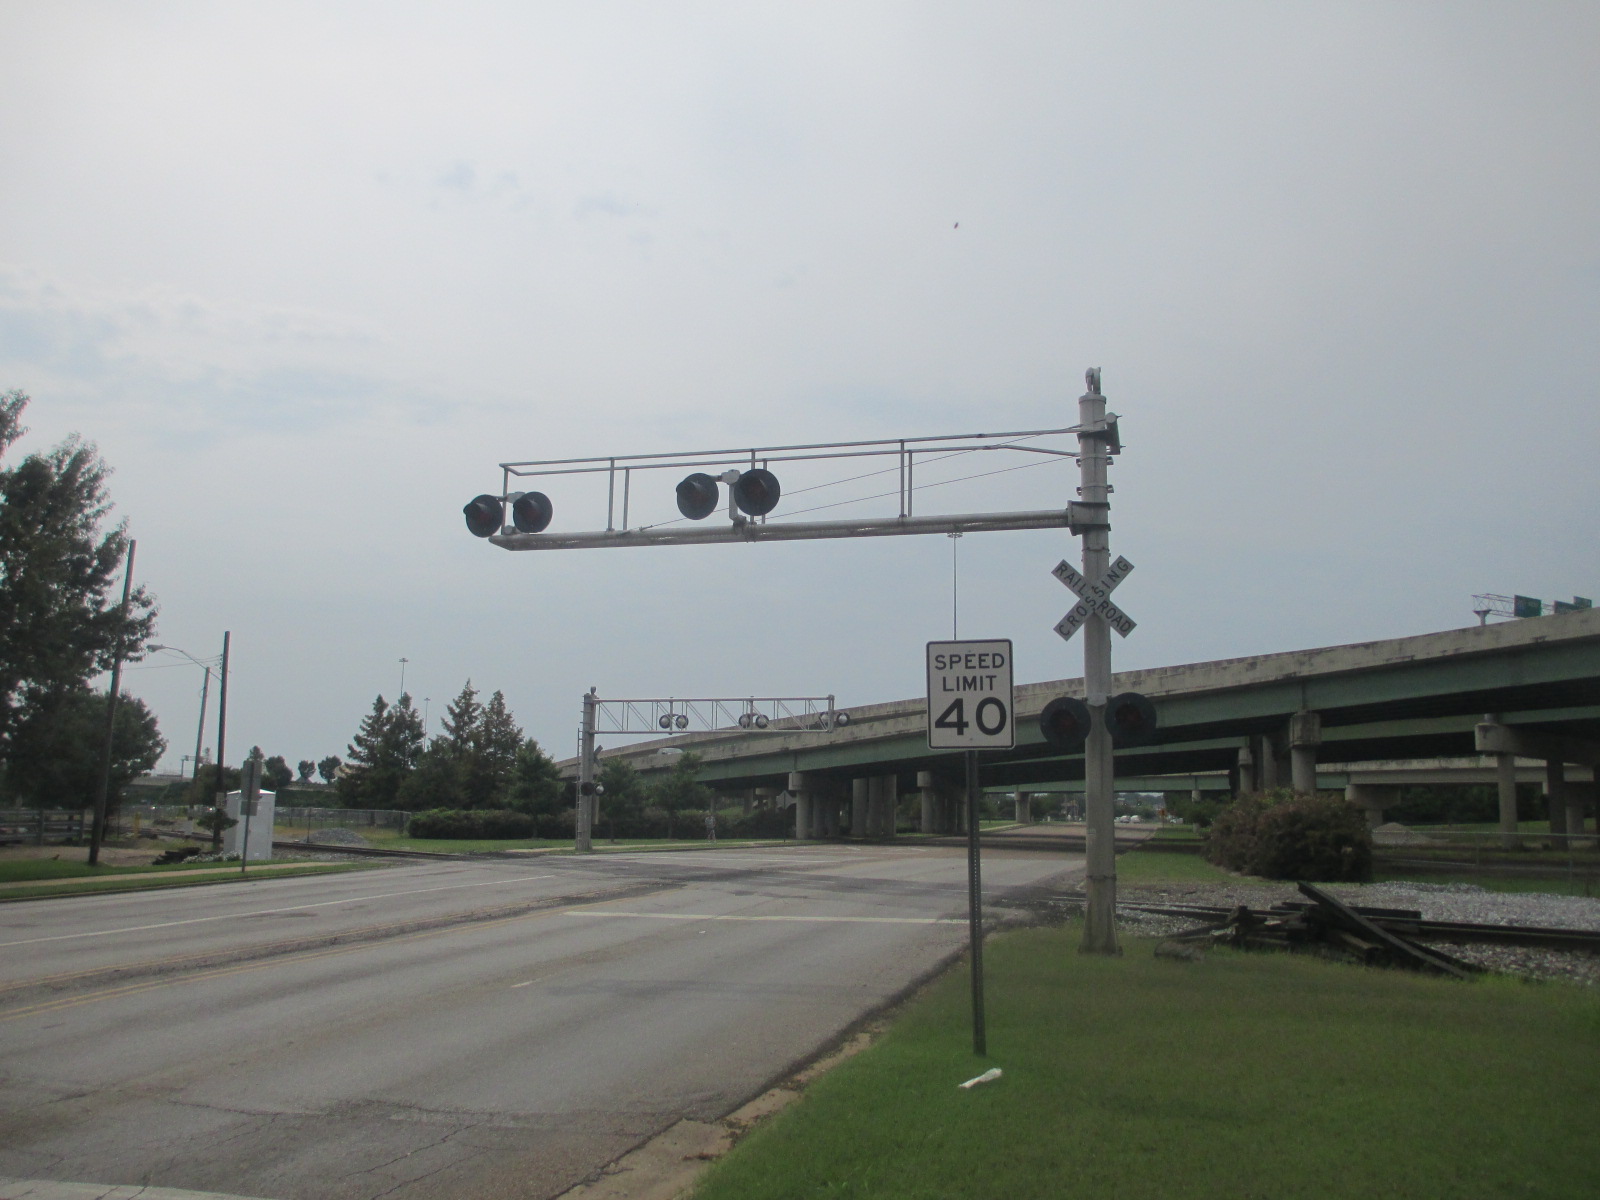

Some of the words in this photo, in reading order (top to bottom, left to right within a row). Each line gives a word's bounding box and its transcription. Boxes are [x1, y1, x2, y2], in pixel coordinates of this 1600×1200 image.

[1058, 559, 1130, 637] CROSSING
[934, 653, 1005, 670] SPEED
[942, 675, 997, 692] LIMIT
[934, 697, 1007, 736] 40
